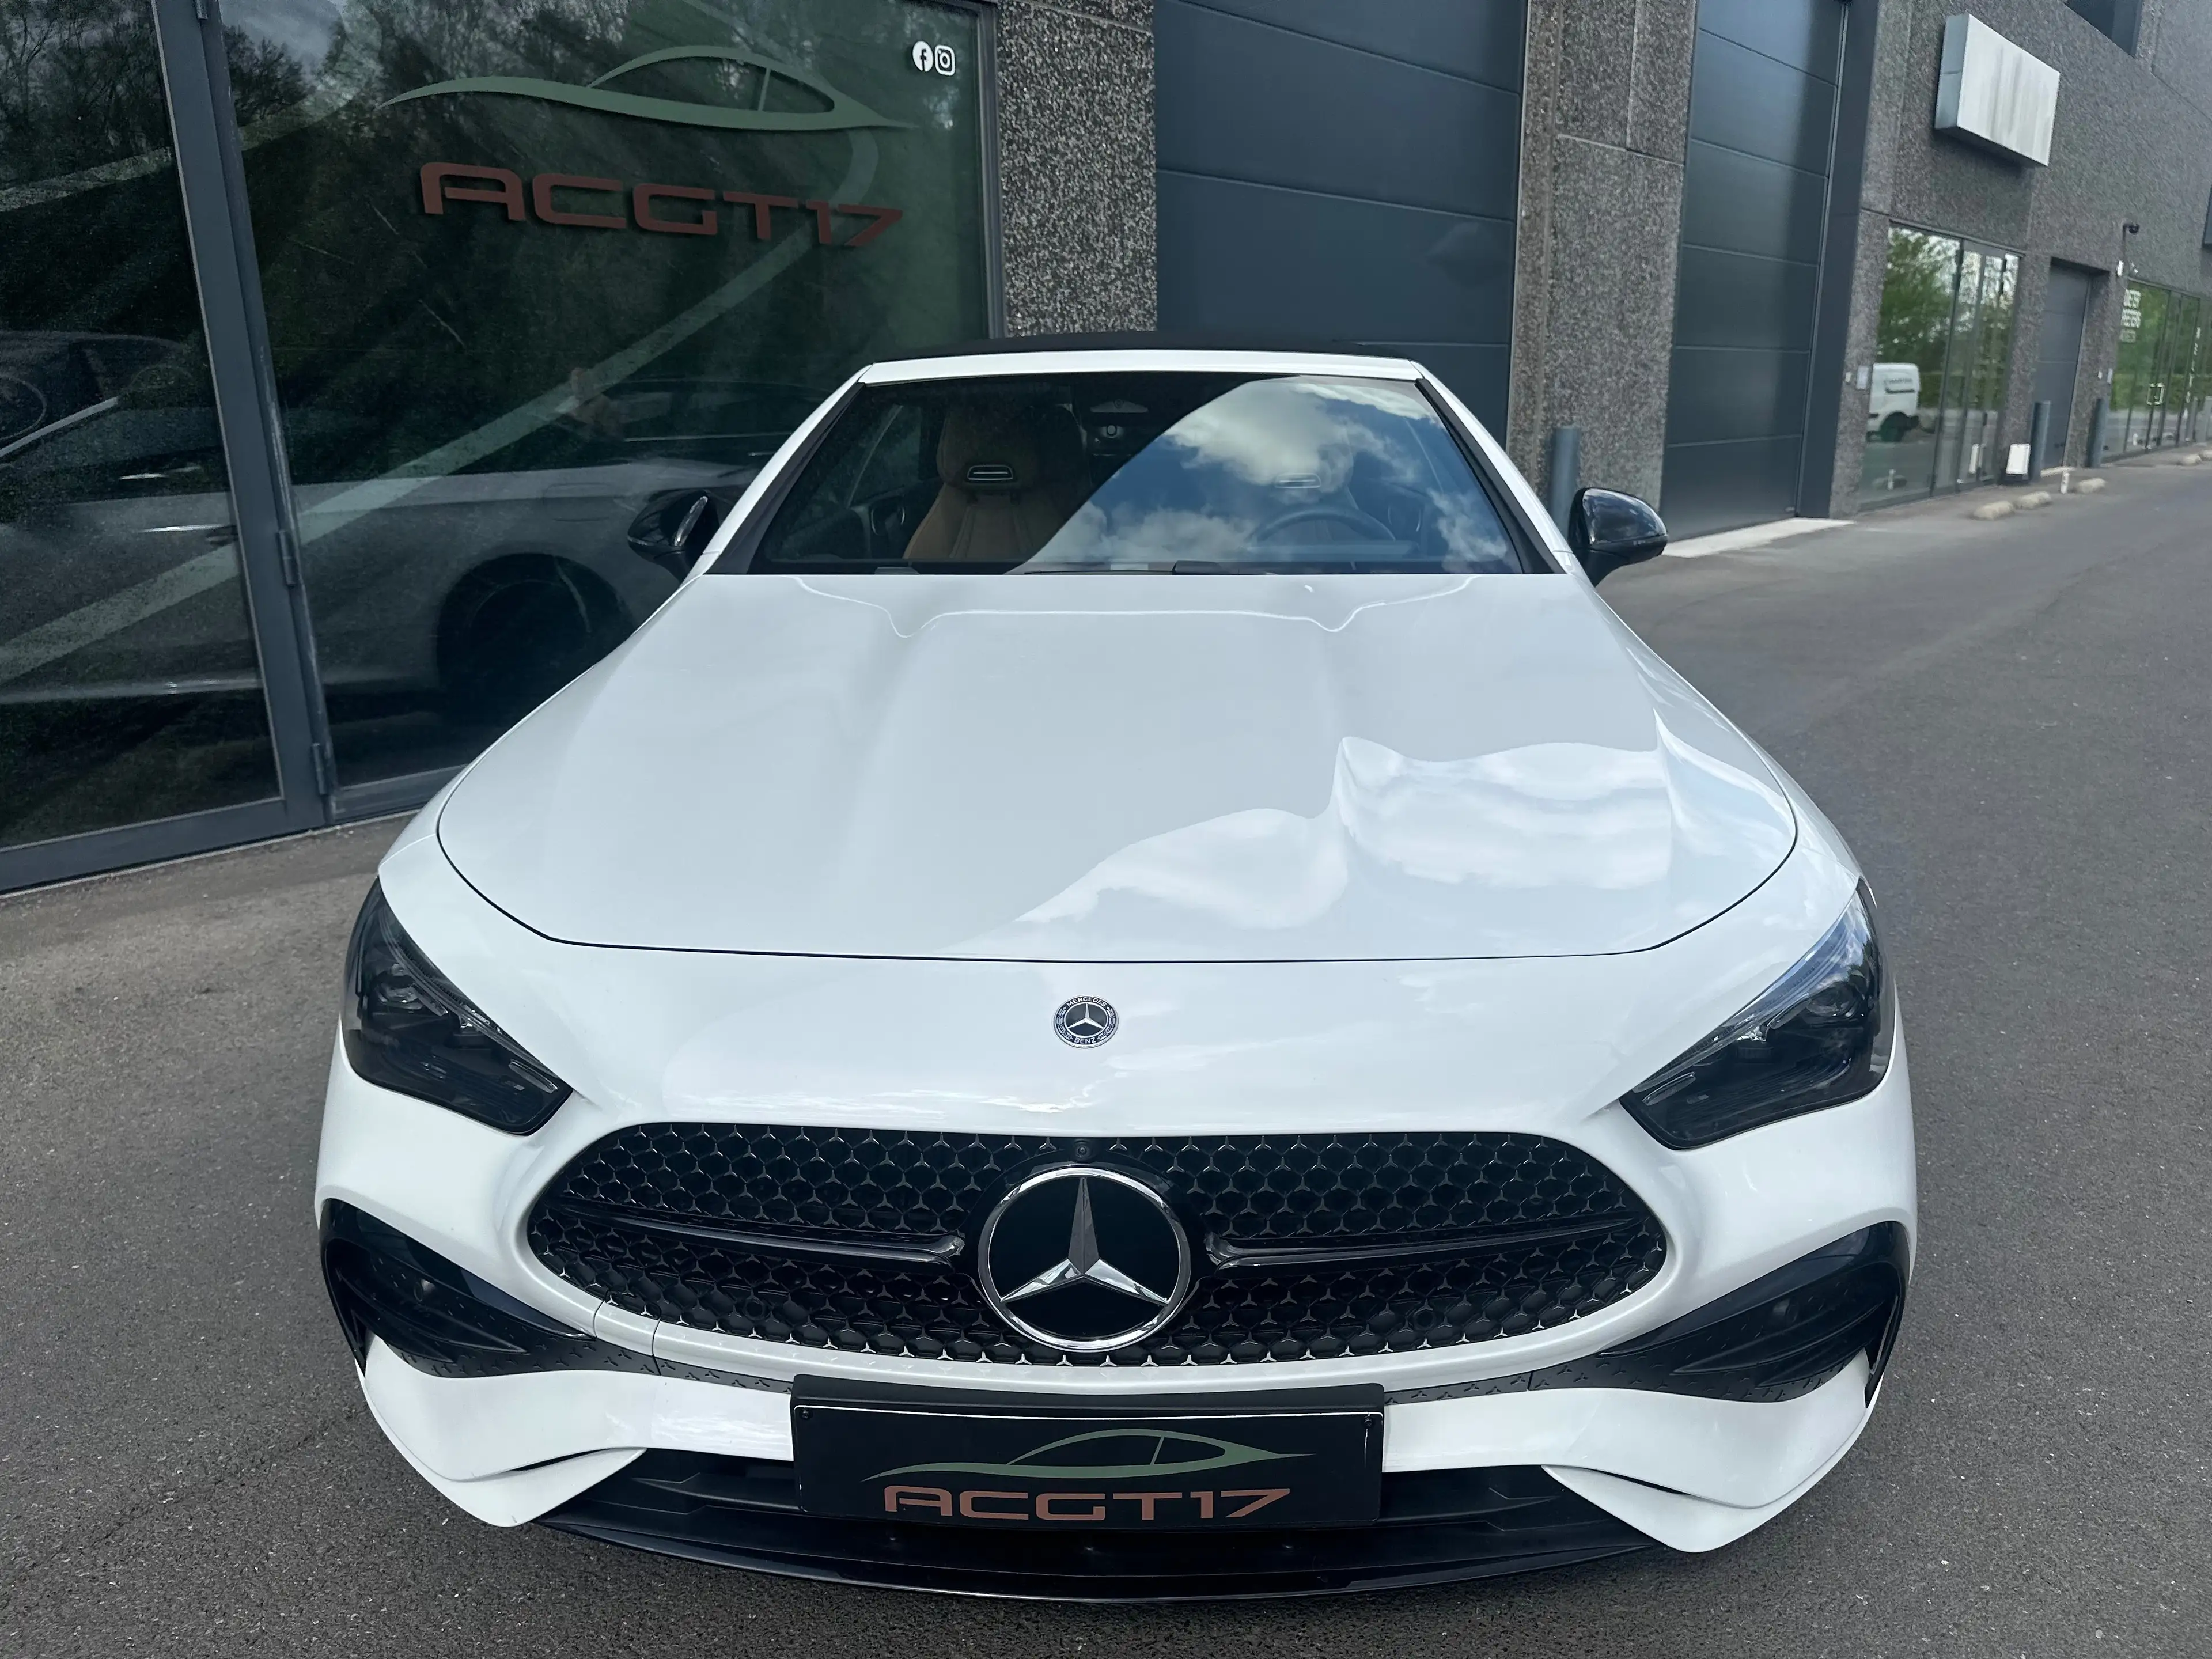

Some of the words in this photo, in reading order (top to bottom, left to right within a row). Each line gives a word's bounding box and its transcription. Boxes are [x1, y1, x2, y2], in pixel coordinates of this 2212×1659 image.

[421, 162, 904, 247] ACGT17
[1066, 997, 1107, 1007] MERCEDES
[884, 1485, 1290, 1521] ACGT17
